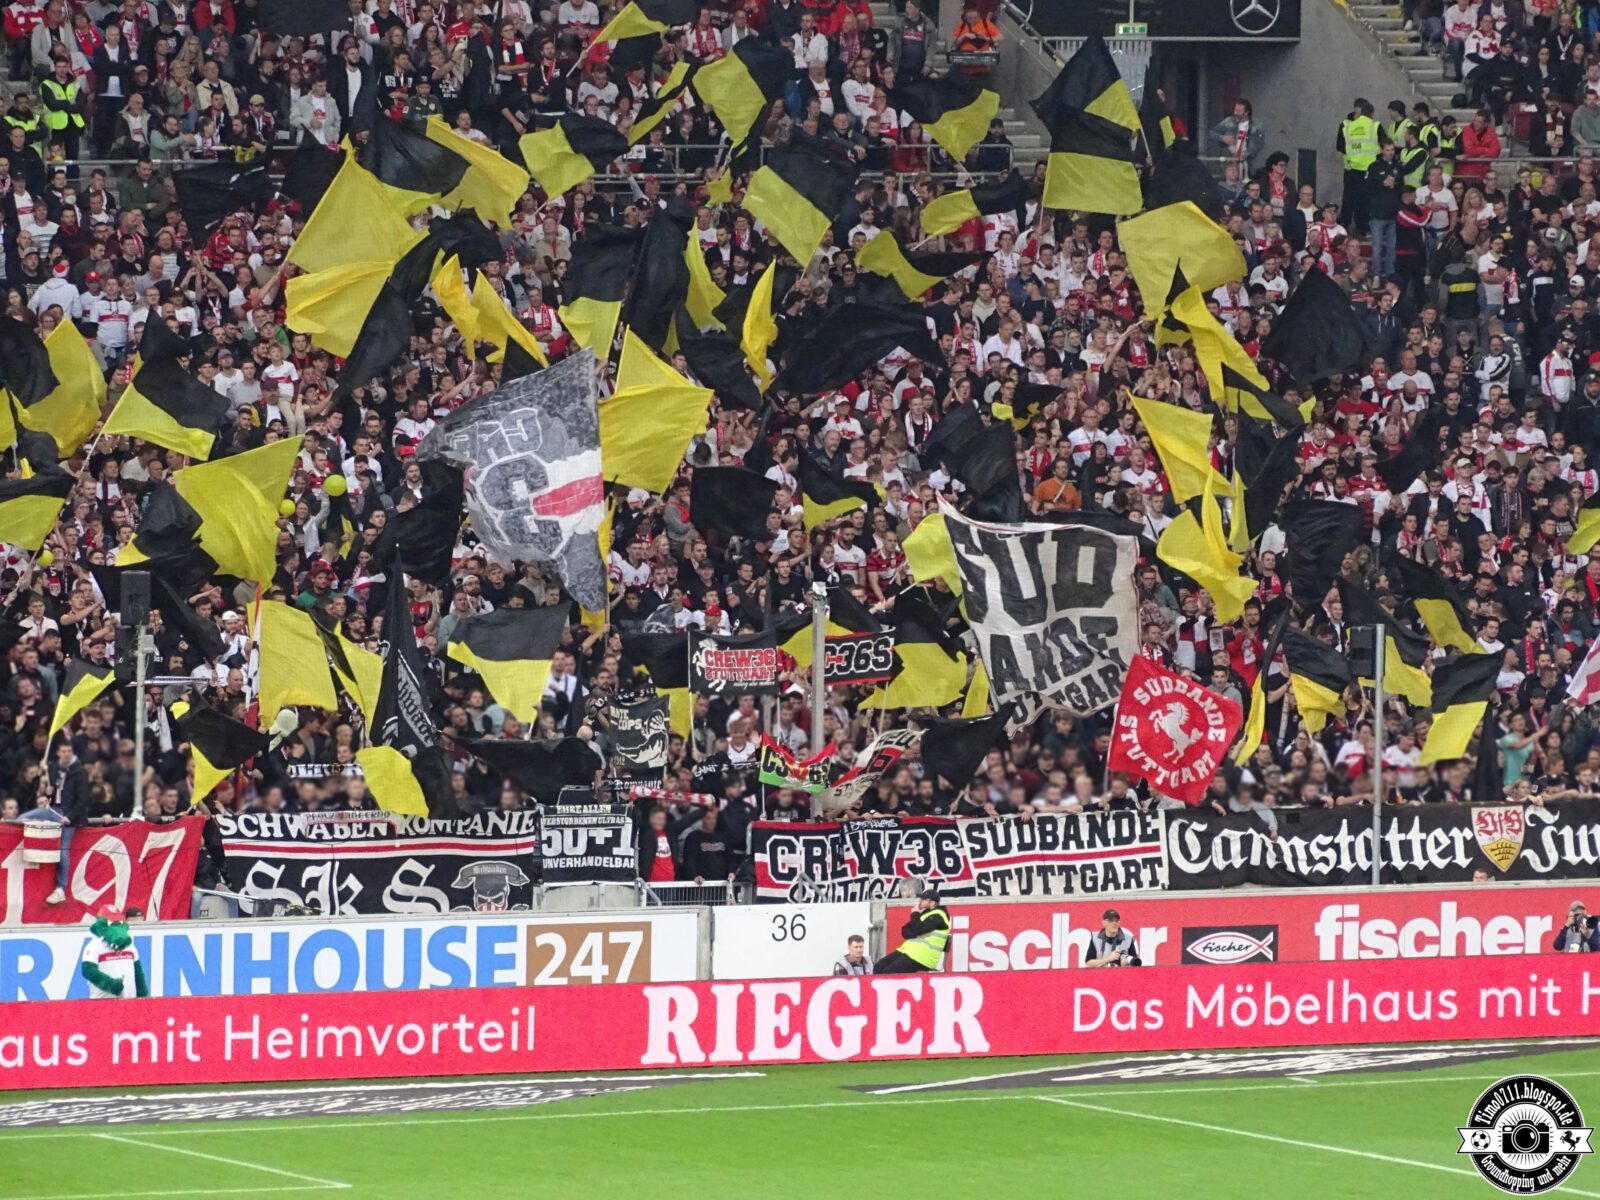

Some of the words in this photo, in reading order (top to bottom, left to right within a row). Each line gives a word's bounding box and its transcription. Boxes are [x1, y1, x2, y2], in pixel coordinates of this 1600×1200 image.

[617, 718, 643, 731] COPS
[1133, 675, 1227, 743] SÜDBANDE
[1120, 714, 1217, 787] STUTTGART
[216, 812, 389, 841] SCHWABEN
[540, 817, 635, 857] 50+1
[556, 804, 582, 814] EHRE
[976, 856, 1164, 897] STUTTGART
[771, 913, 806, 942] 36
[952, 911, 1168, 973] ischr
[1201, 940, 1254, 955] fischer
[1314, 900, 1553, 961] fischer
[533, 930, 644, 986] 247
[640, 976, 991, 1065] RIEGER
[1073, 987, 1164, 1032] Das
[1186, 979, 1458, 1029] Möbelhaus
[1480, 973, 1562, 1019] mit
[112, 1017, 202, 1064] mit
[225, 1004, 536, 1061] Heimvorteil
